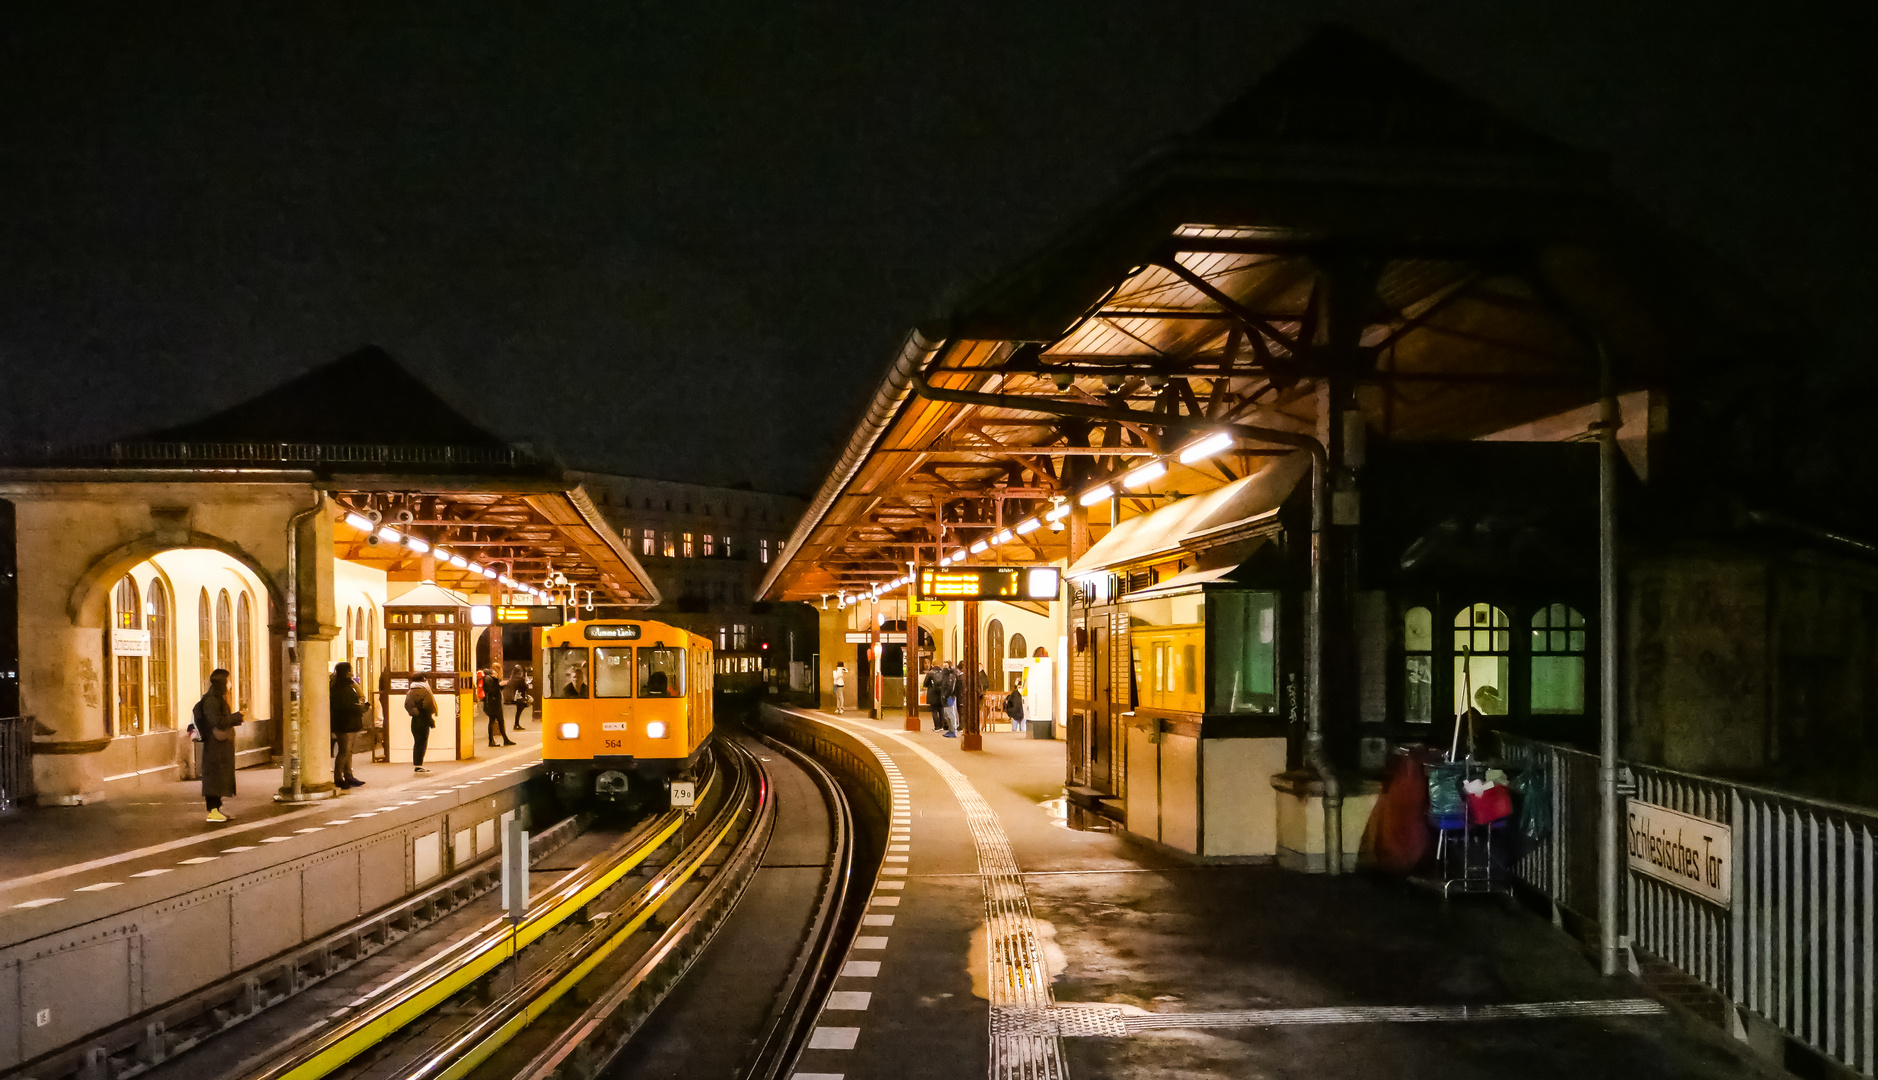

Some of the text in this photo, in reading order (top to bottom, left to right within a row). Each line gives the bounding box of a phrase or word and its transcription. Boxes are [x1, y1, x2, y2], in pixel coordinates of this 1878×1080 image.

[605, 739, 622, 748] 564
[1629, 812, 1723, 890] Schlesisches Tor
